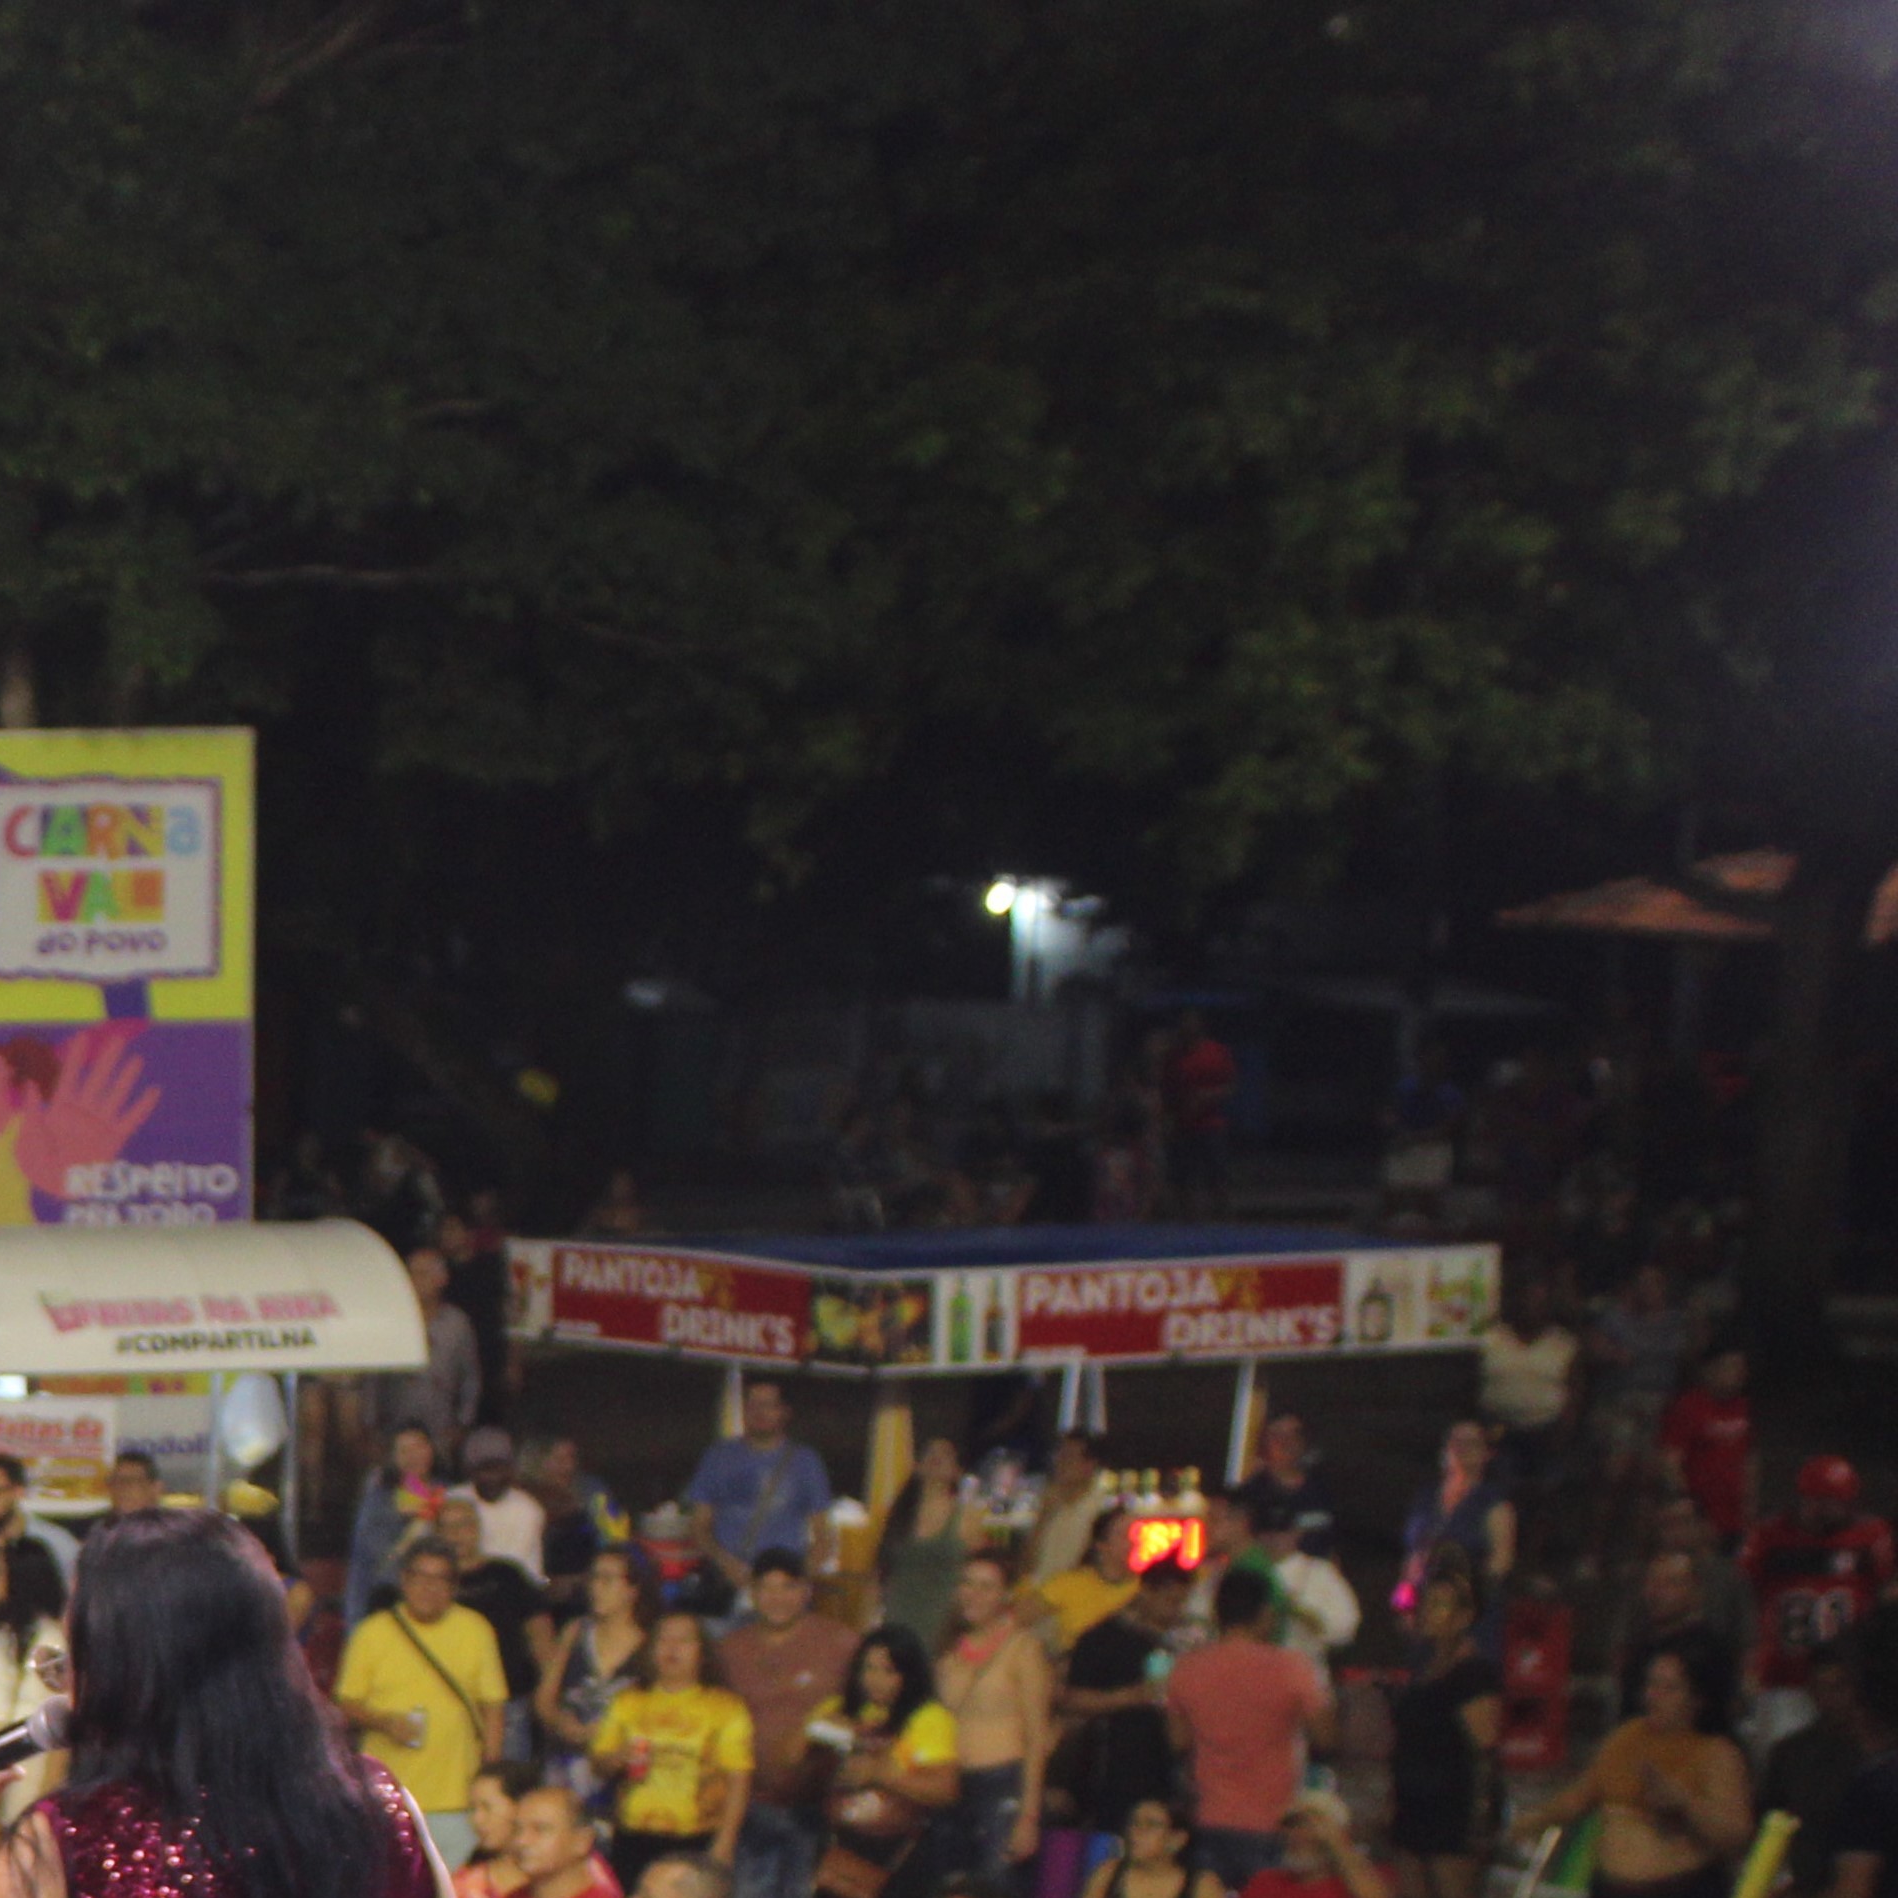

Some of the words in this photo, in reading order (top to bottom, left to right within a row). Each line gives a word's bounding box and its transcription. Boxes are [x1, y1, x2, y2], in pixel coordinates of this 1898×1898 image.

[37, 869, 166, 924] VAL
[560, 1250, 704, 1300] PANTOJA
[1022, 1266, 1221, 1315] PANTOJA
[660, 1301, 799, 1356] DRINK'S
[1163, 1302, 1341, 1350] DRINK'S
